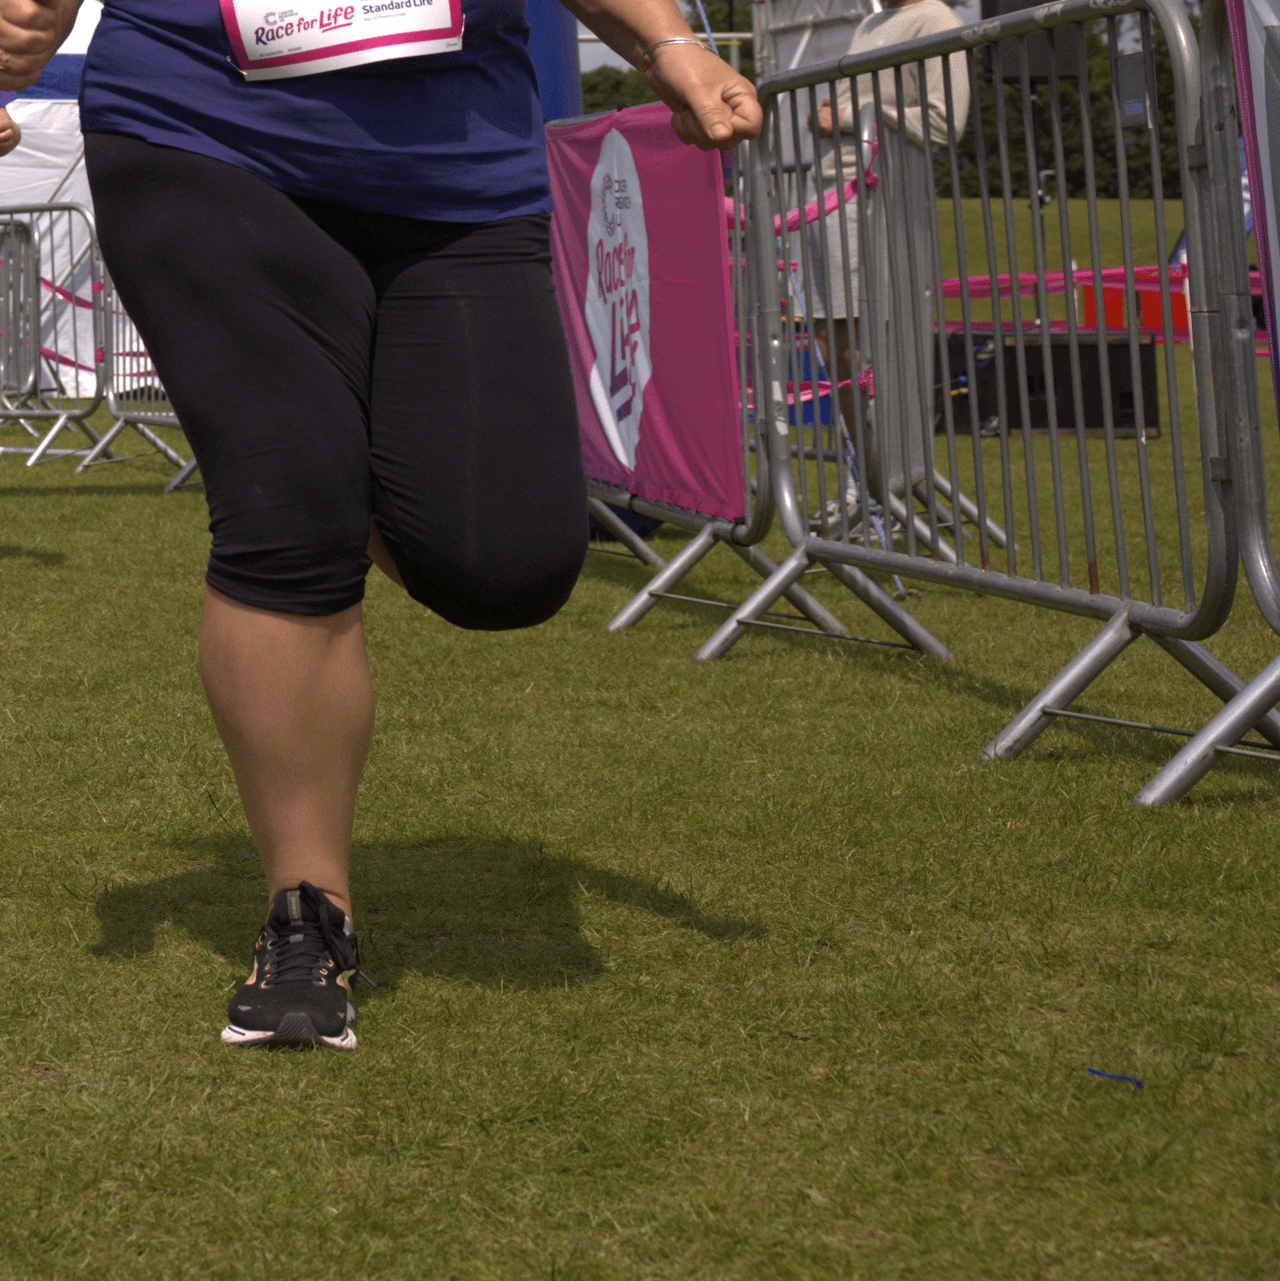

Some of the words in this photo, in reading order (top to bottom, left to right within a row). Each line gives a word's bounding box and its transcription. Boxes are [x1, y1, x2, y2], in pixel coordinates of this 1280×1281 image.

[254, 22, 294, 46] Race
[295, 17, 318, 33] for
[318, 5, 355, 30] Life
